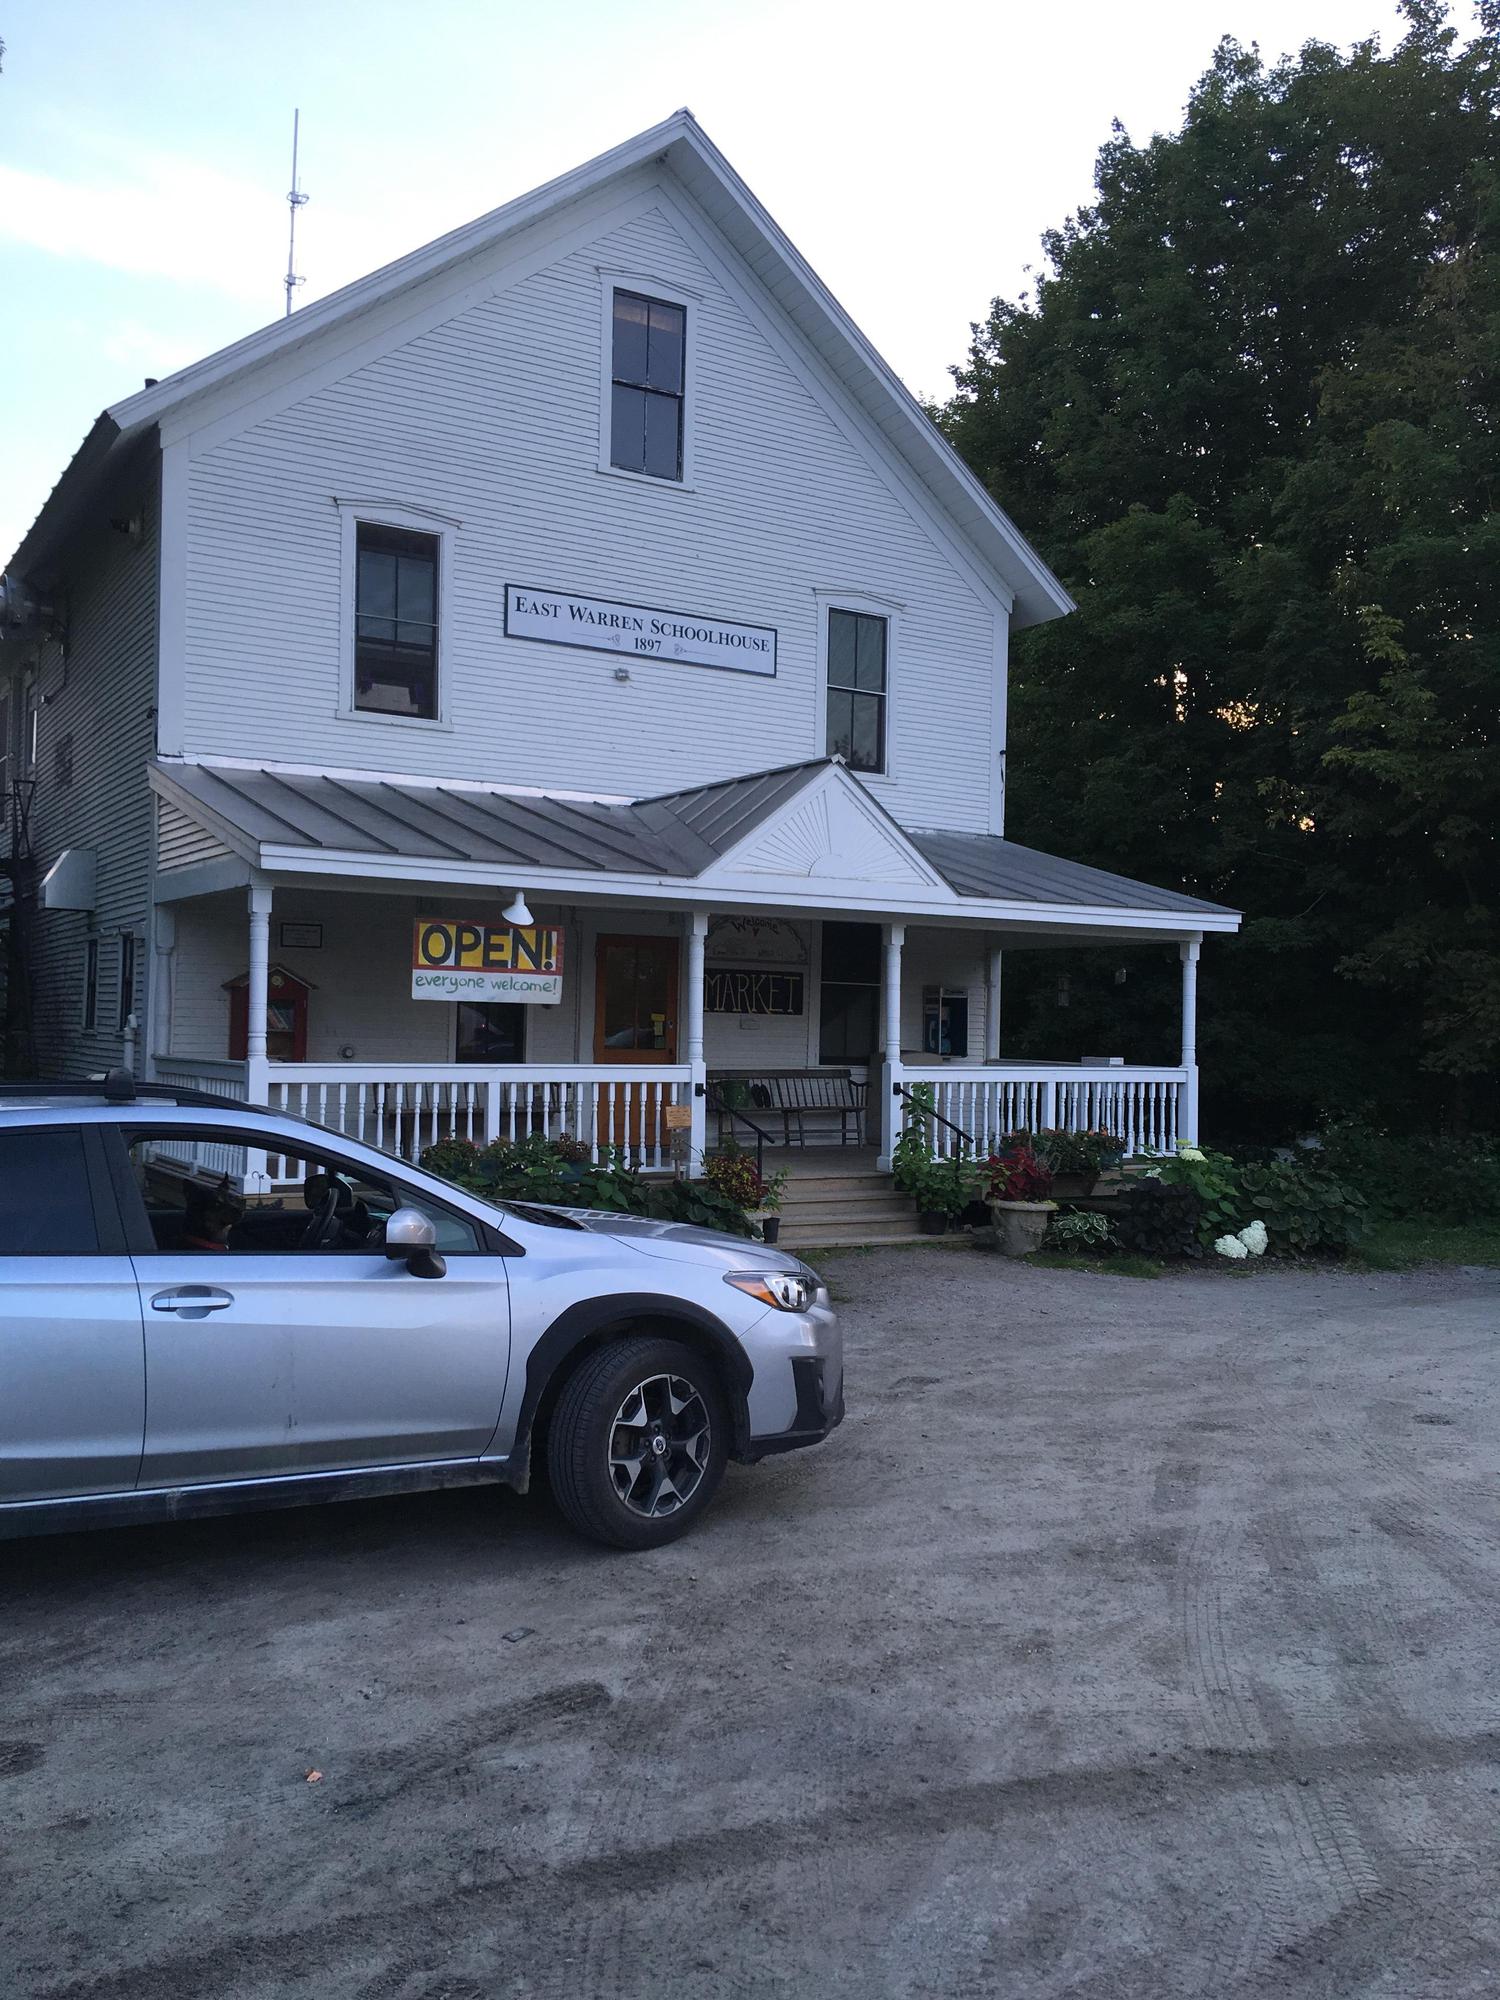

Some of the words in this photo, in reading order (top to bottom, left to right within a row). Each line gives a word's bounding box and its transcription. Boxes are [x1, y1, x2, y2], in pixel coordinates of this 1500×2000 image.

[515, 596, 561, 618] EAST
[568, 605, 644, 631] WARREN
[650, 619, 770, 653] SCHOOLHOUSE
[633, 636, 662, 654] 1897
[421, 924, 554, 971] OPEN!
[415, 974, 485, 994] everyone
[490, 976, 558, 995] welcome!
[703, 973, 800, 1014] MARKET
